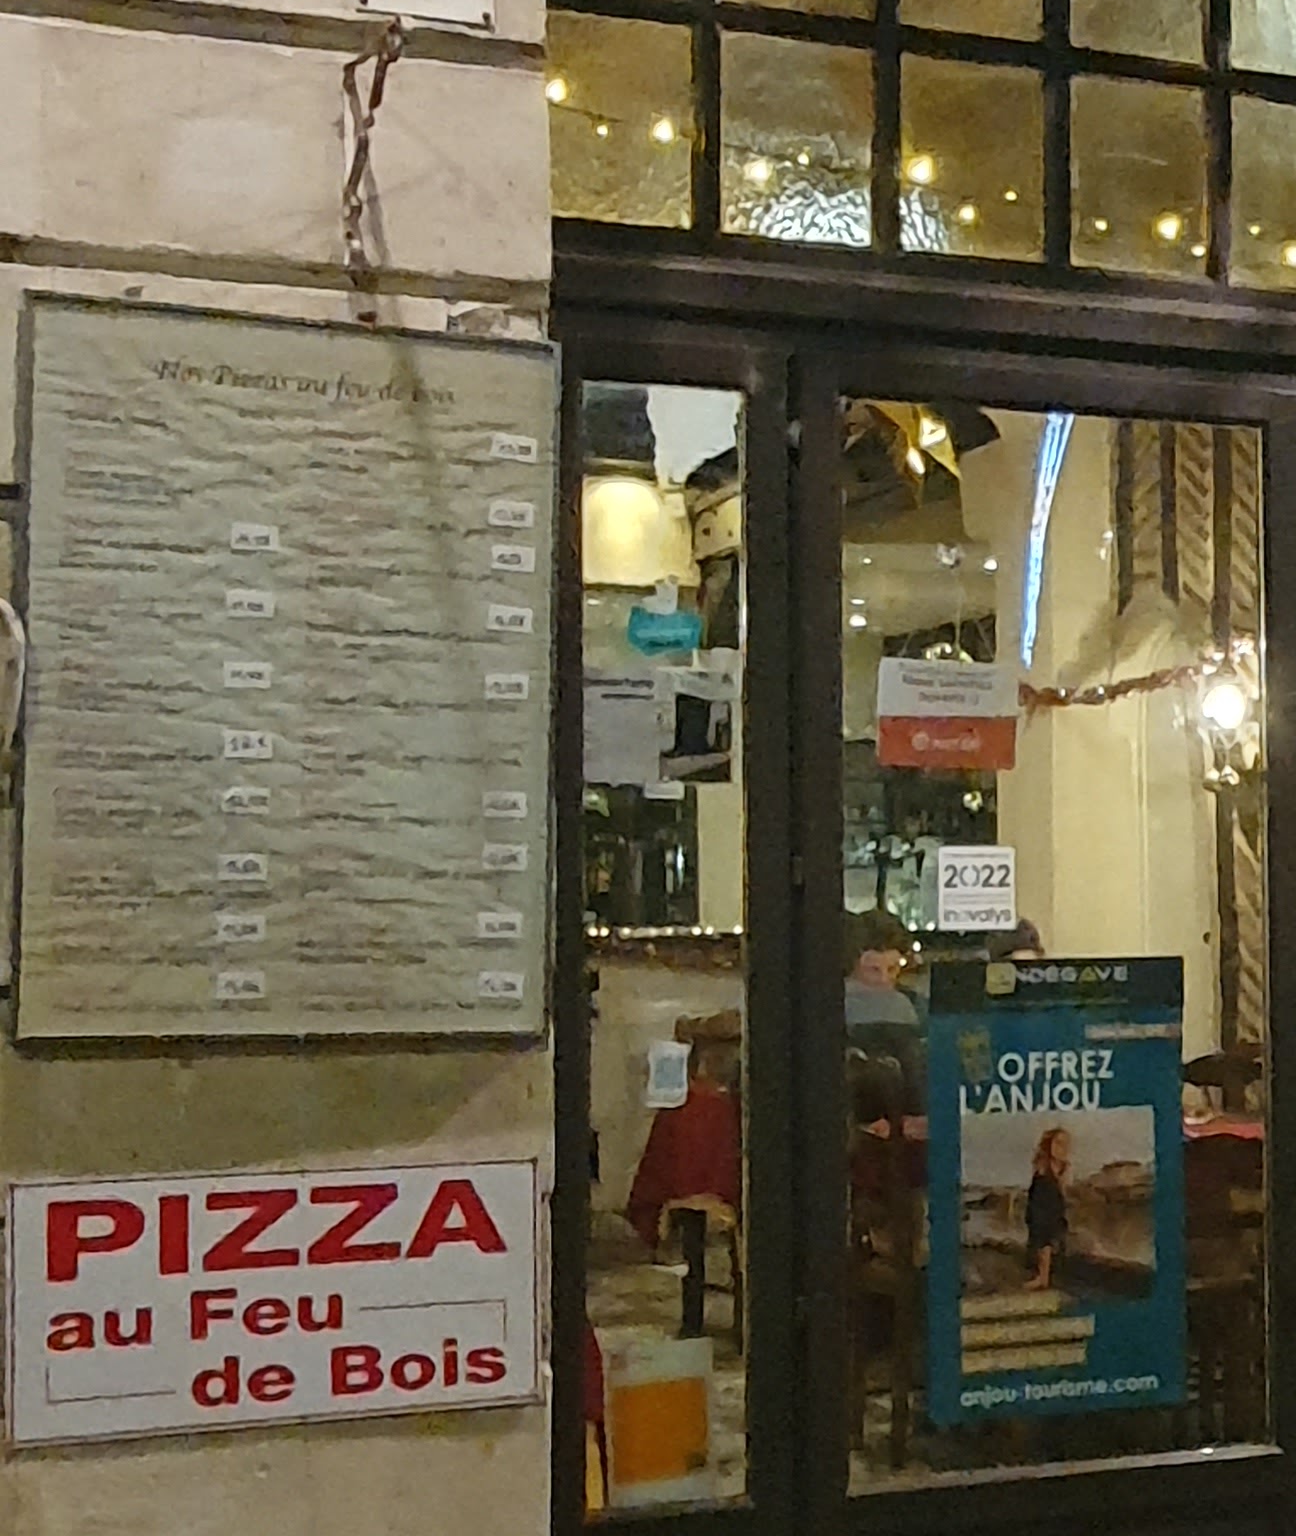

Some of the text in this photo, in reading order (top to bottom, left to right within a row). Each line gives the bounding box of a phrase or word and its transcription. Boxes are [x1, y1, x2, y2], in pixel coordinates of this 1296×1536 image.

[944, 864, 1011, 888] 2022
[998, 1049, 1115, 1083] OFFREZ
[959, 1080, 1100, 1115] L'ANJOU
[46, 1179, 508, 1282] PIZZA
[46, 1288, 344, 1352] au Feu
[191, 1338, 507, 1407] de Bois
